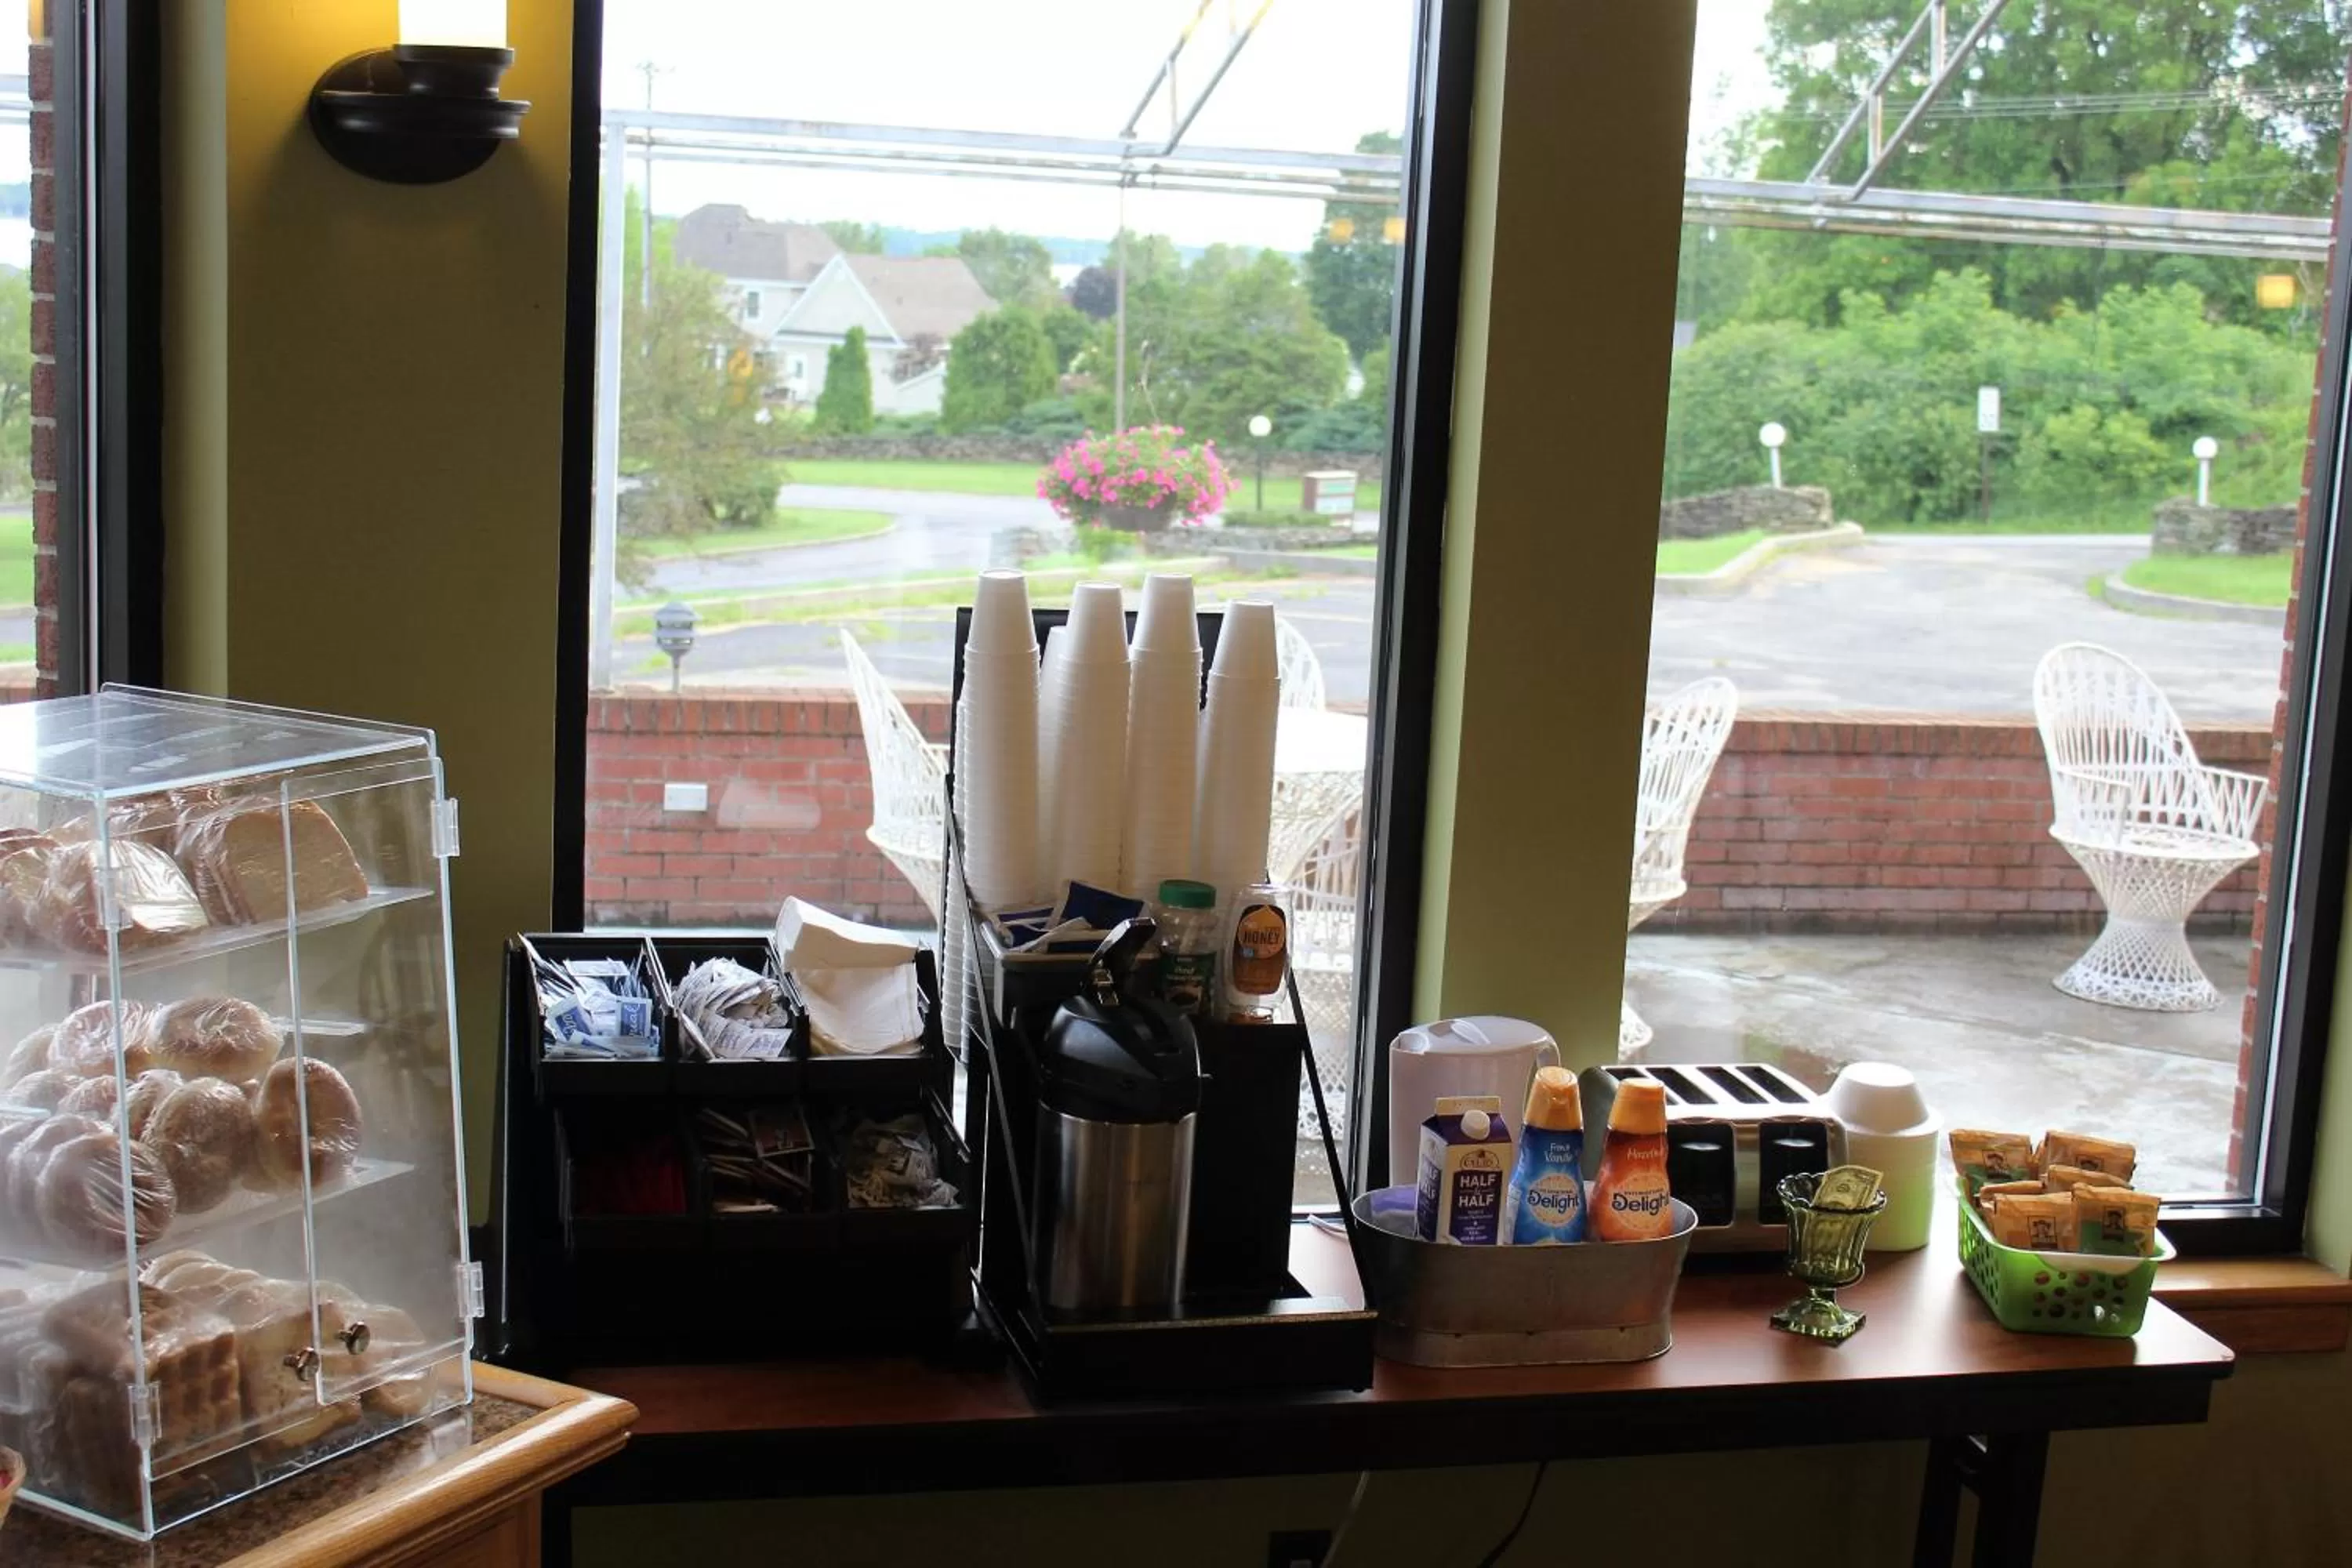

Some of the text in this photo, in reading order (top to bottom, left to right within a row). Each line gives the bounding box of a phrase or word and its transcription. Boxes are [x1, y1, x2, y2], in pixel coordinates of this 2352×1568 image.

[1243, 931, 1279, 945] HONEY
[1460, 1174, 1497, 1188] HALF
[1458, 1193, 1495, 1207] HALF
[1528, 1189, 1581, 1214] Delight
[1612, 1191, 1670, 1216] Delight
